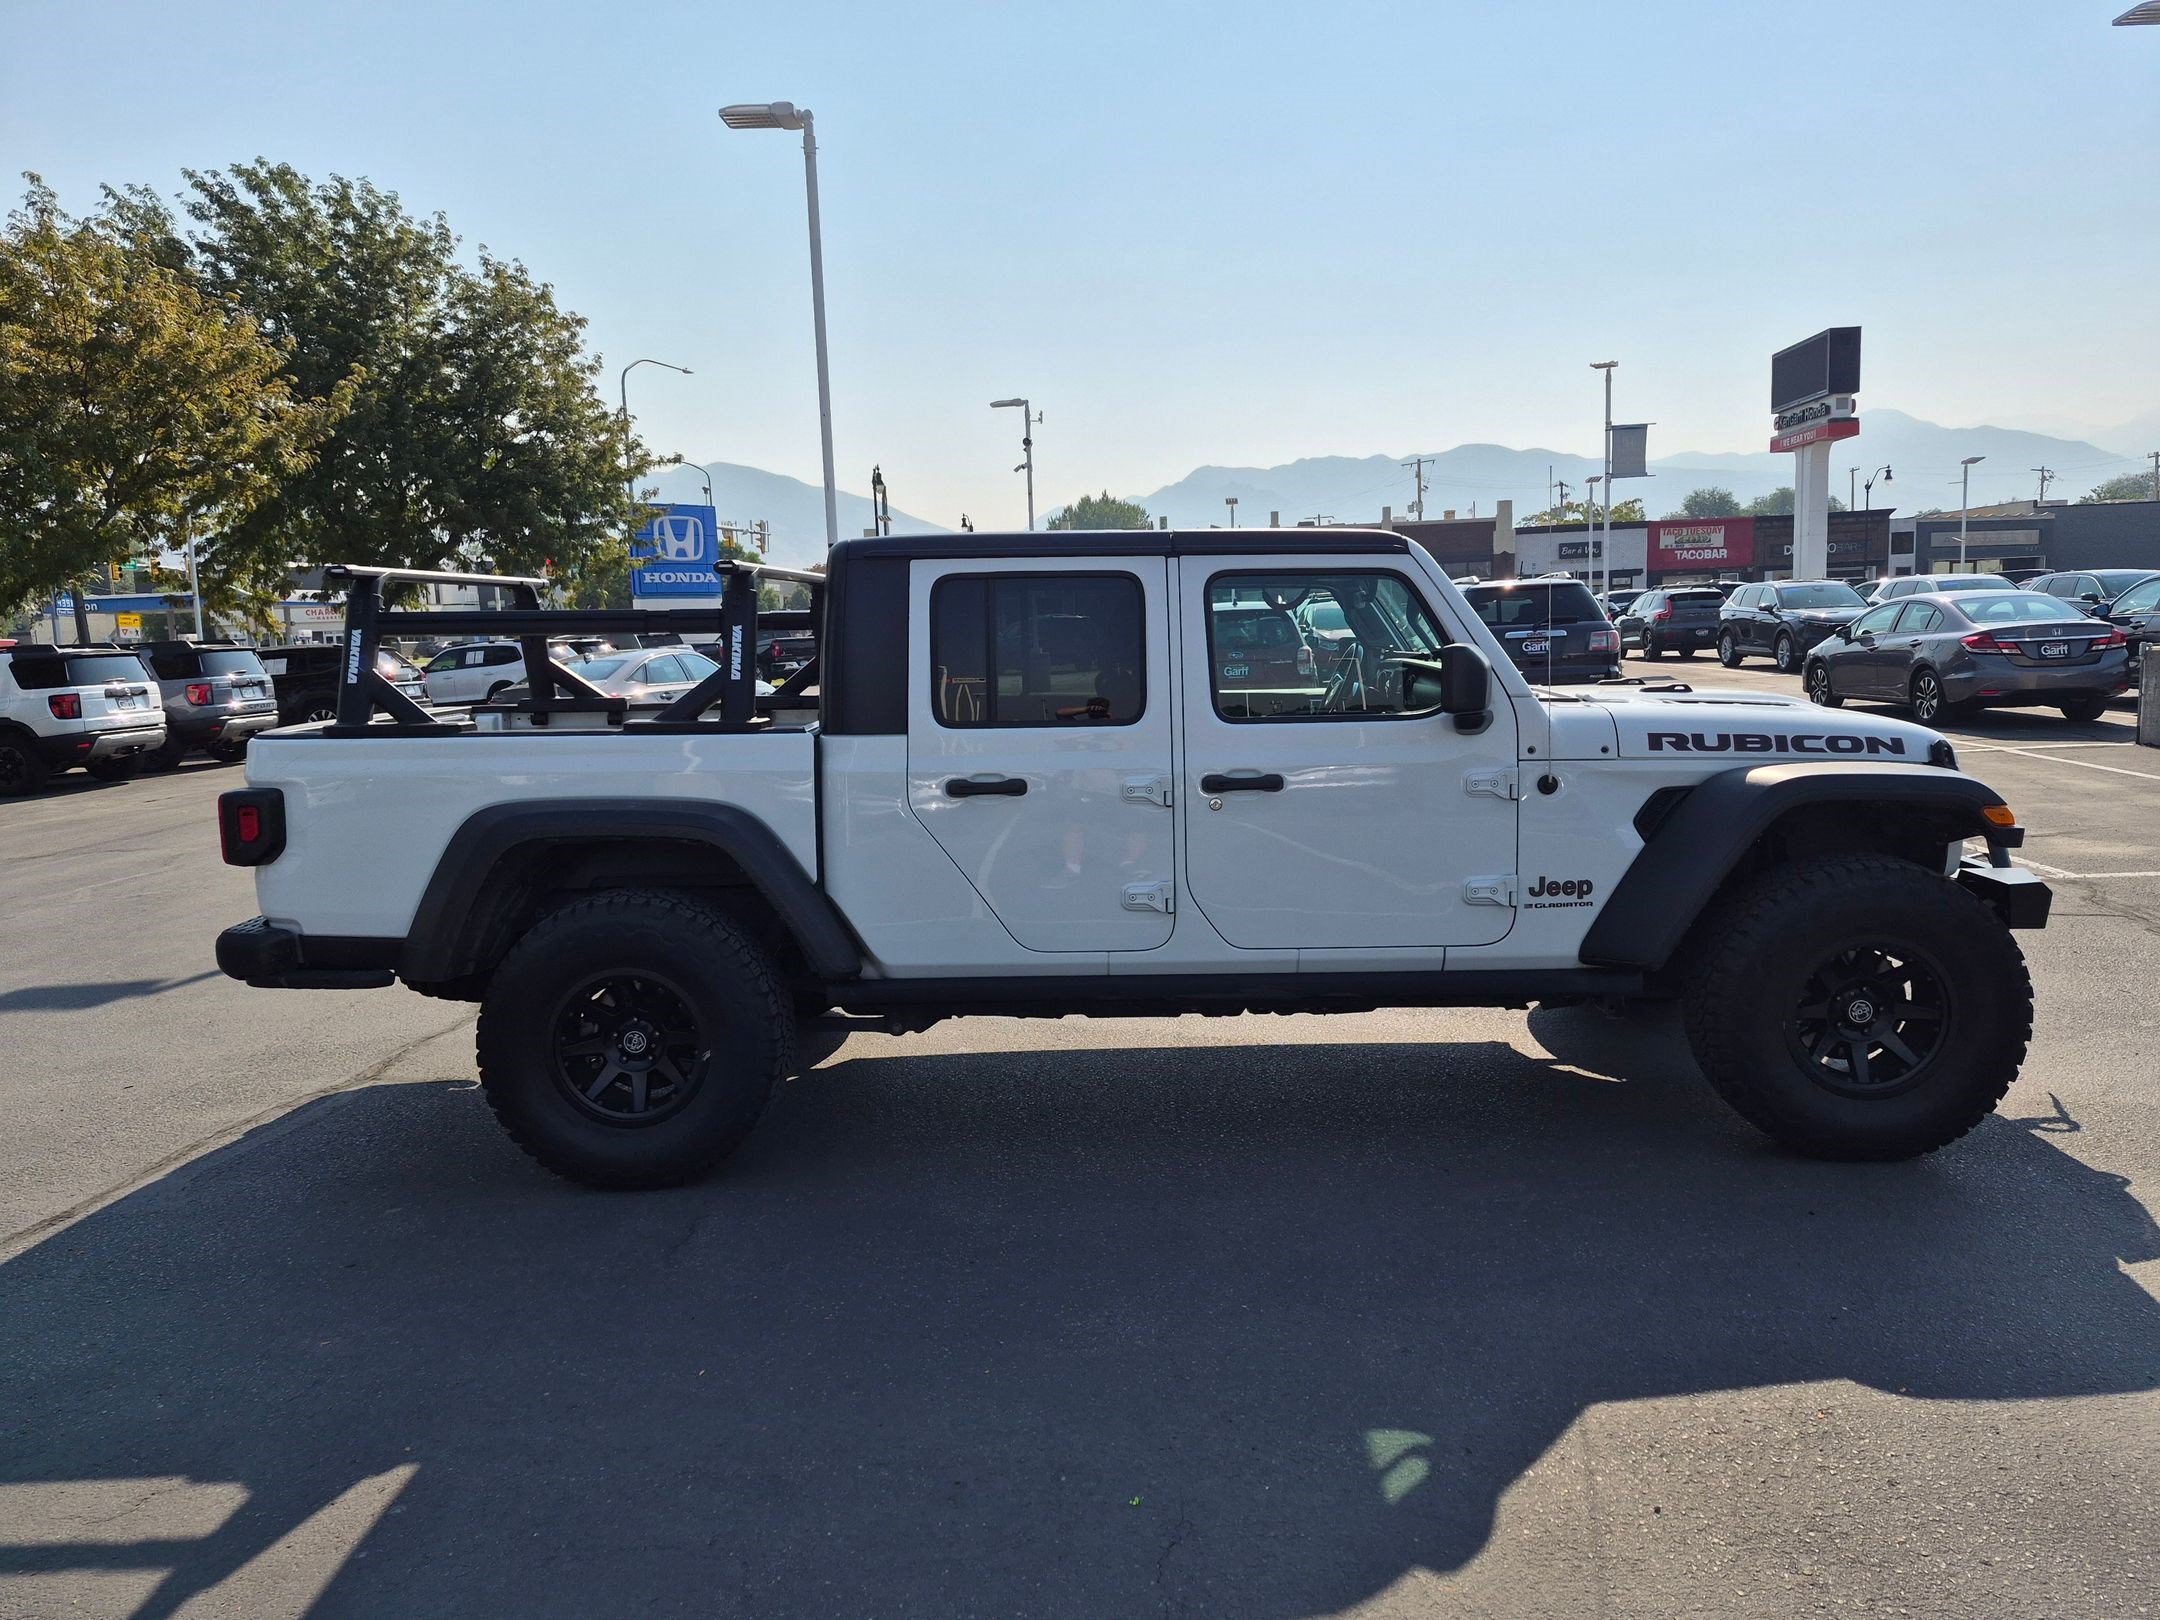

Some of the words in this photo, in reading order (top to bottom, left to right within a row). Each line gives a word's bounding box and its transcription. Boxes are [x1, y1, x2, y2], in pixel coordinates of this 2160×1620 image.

[1662, 528, 1684, 536] TACO
[1686, 526, 1723, 536] TUESDAY
[1674, 548, 1728, 560] TACOBAR
[643, 572, 718, 583] HONDA
[730, 624, 743, 680] YAKIMA
[2041, 645, 2068, 655] Garff
[347, 629, 362, 684] YAKIMA
[1224, 666, 1249, 676] Garff
[1647, 732, 1906, 755] RUBICON
[1528, 876, 1593, 900] Jeep
[1534, 901, 1594, 909] GLADIATOR
